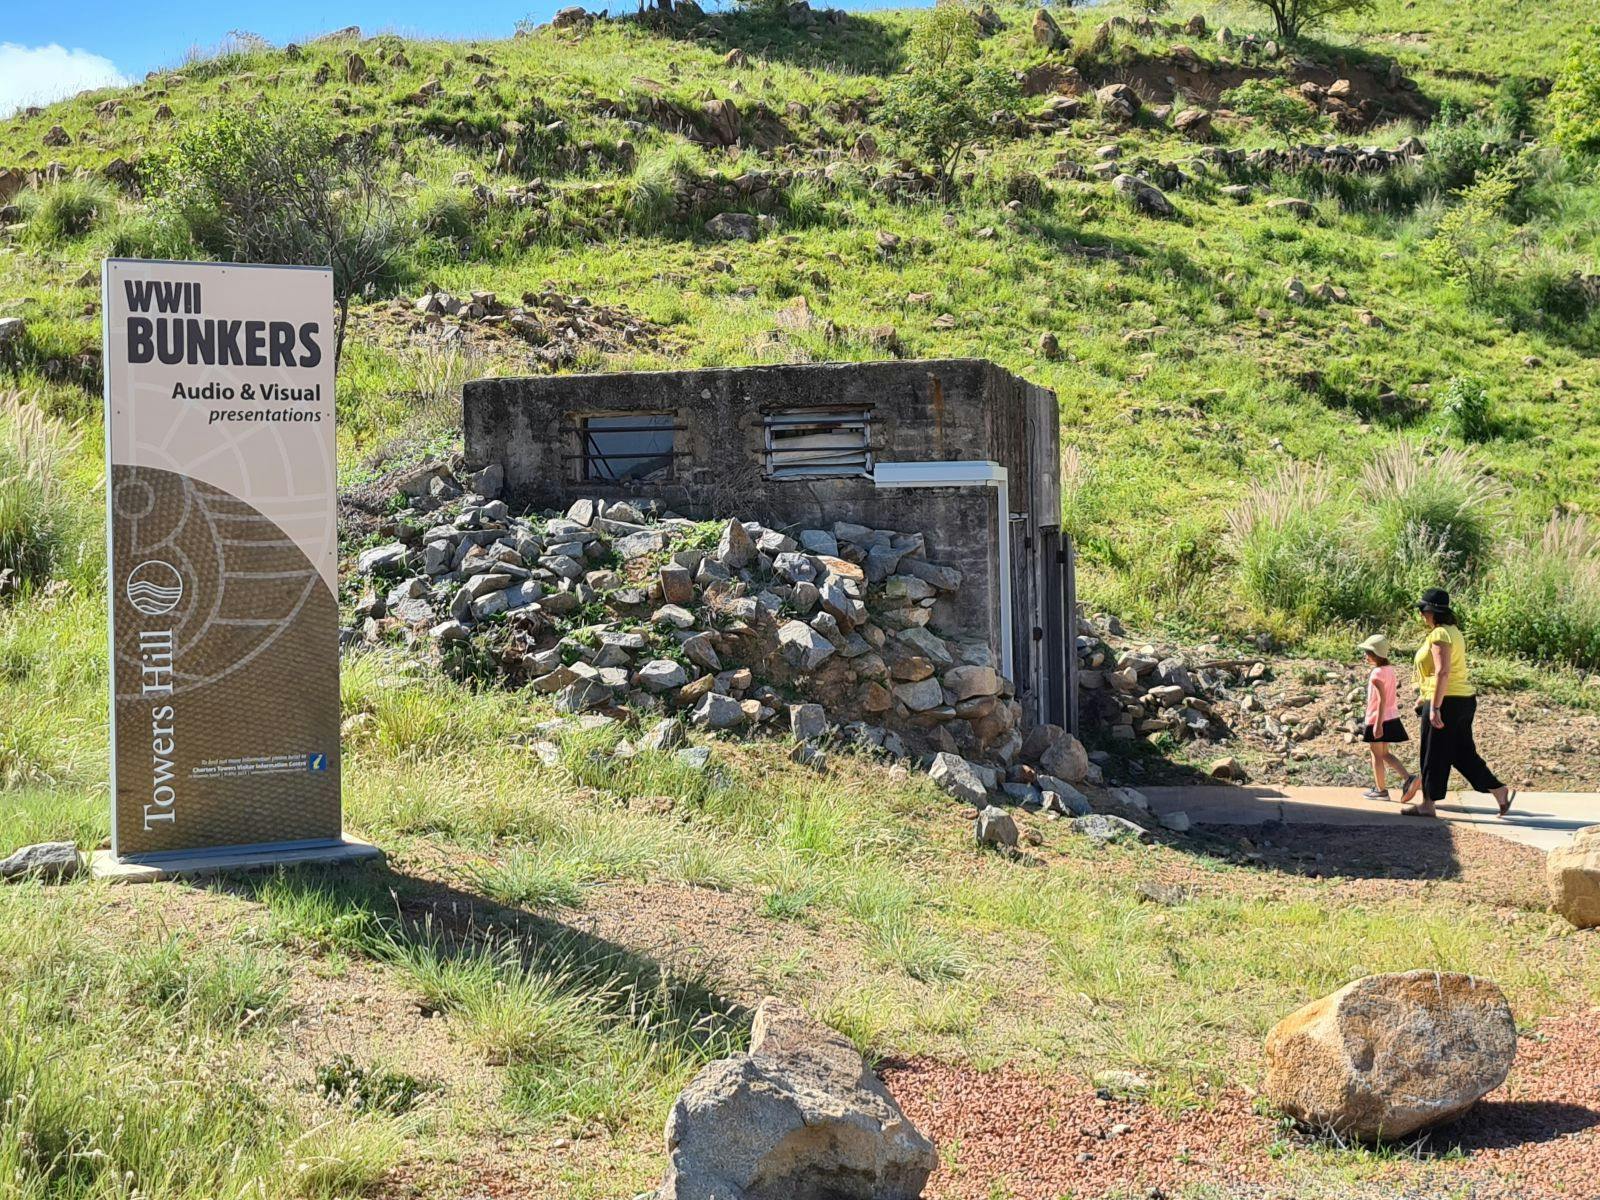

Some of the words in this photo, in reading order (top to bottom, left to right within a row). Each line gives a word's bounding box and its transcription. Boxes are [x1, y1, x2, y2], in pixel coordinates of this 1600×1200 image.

[124, 280, 201, 314] WWII
[127, 316, 322, 368] BUNKERS
[172, 382, 235, 400] Audio
[240, 383, 256, 400] &
[261, 383, 321, 401] Visual
[209, 407, 322, 424] presentations
[139, 627, 173, 696] Hill
[143, 705, 176, 831] Towers
[237, 763, 255, 771] Visitor
[255, 761, 288, 769] Information
